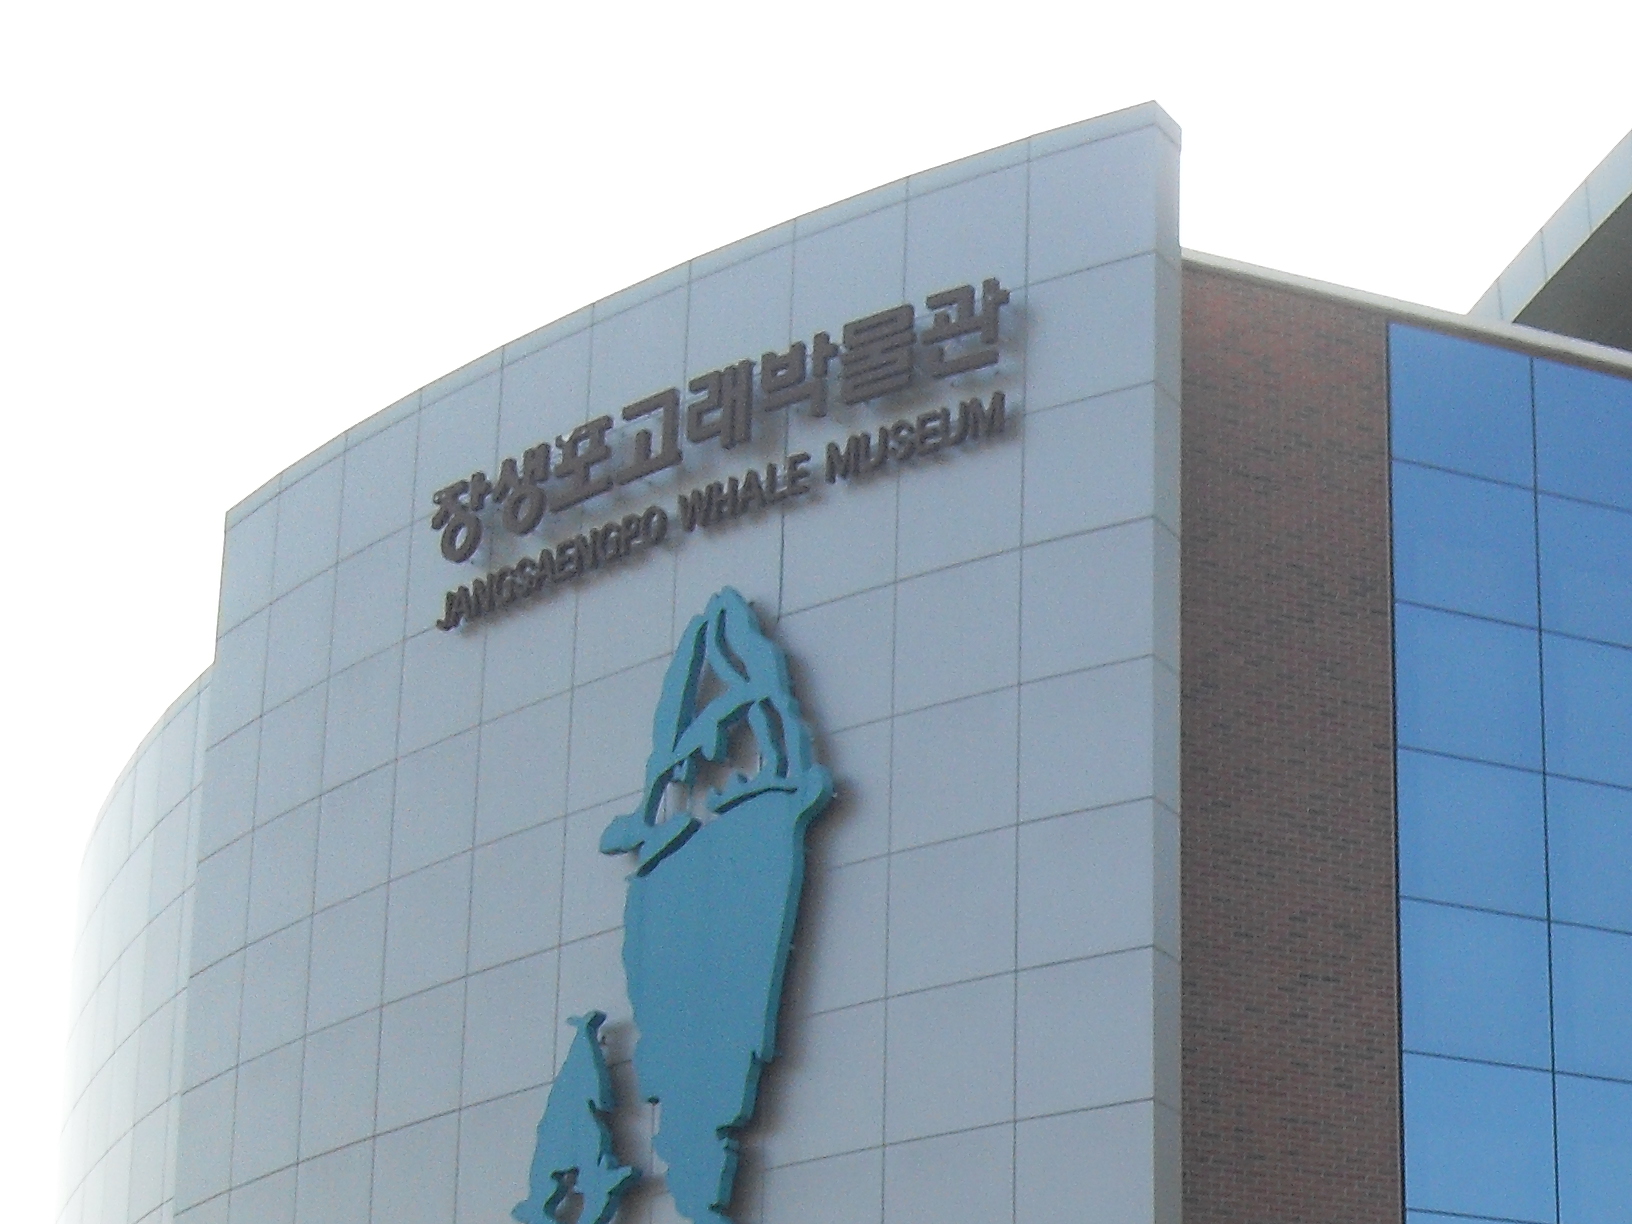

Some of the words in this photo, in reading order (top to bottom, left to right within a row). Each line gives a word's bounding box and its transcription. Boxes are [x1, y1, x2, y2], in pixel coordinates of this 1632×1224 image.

[431, 276, 1010, 563] 장생포고래박물관
[436, 506, 668, 632] JANGSAENGPO
[678, 451, 811, 532] WHALE
[824, 390, 1006, 484] MUSEUM
